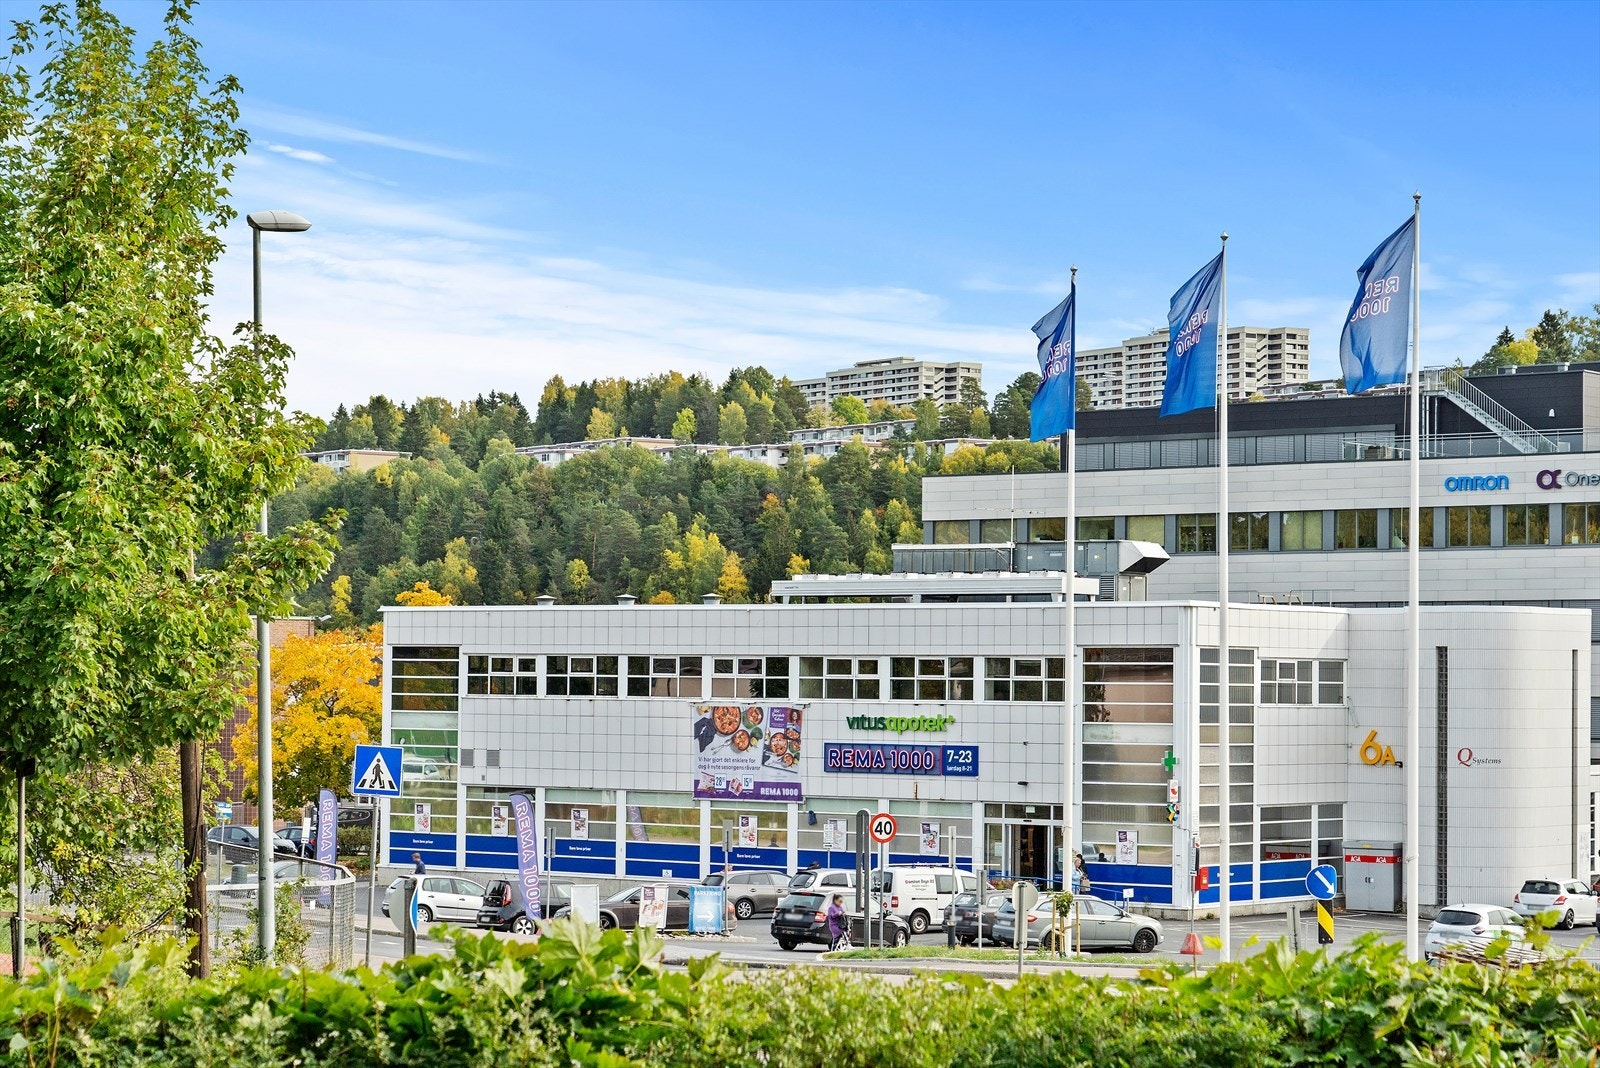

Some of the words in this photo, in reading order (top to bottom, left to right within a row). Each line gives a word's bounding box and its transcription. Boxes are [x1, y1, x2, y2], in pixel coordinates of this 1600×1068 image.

[828, 748, 886, 769] REMA
[890, 750, 934, 770] 1000
[946, 749, 972, 763] 7-23
[1359, 729, 1396, 766] 6A
[760, 787, 780, 795] REMA
[781, 788, 799, 797] 1000
[321, 798, 334, 852] REMA
[515, 801, 536, 863] REMA
[874, 821, 893, 836] 40
[523, 864, 541, 912] 1000
